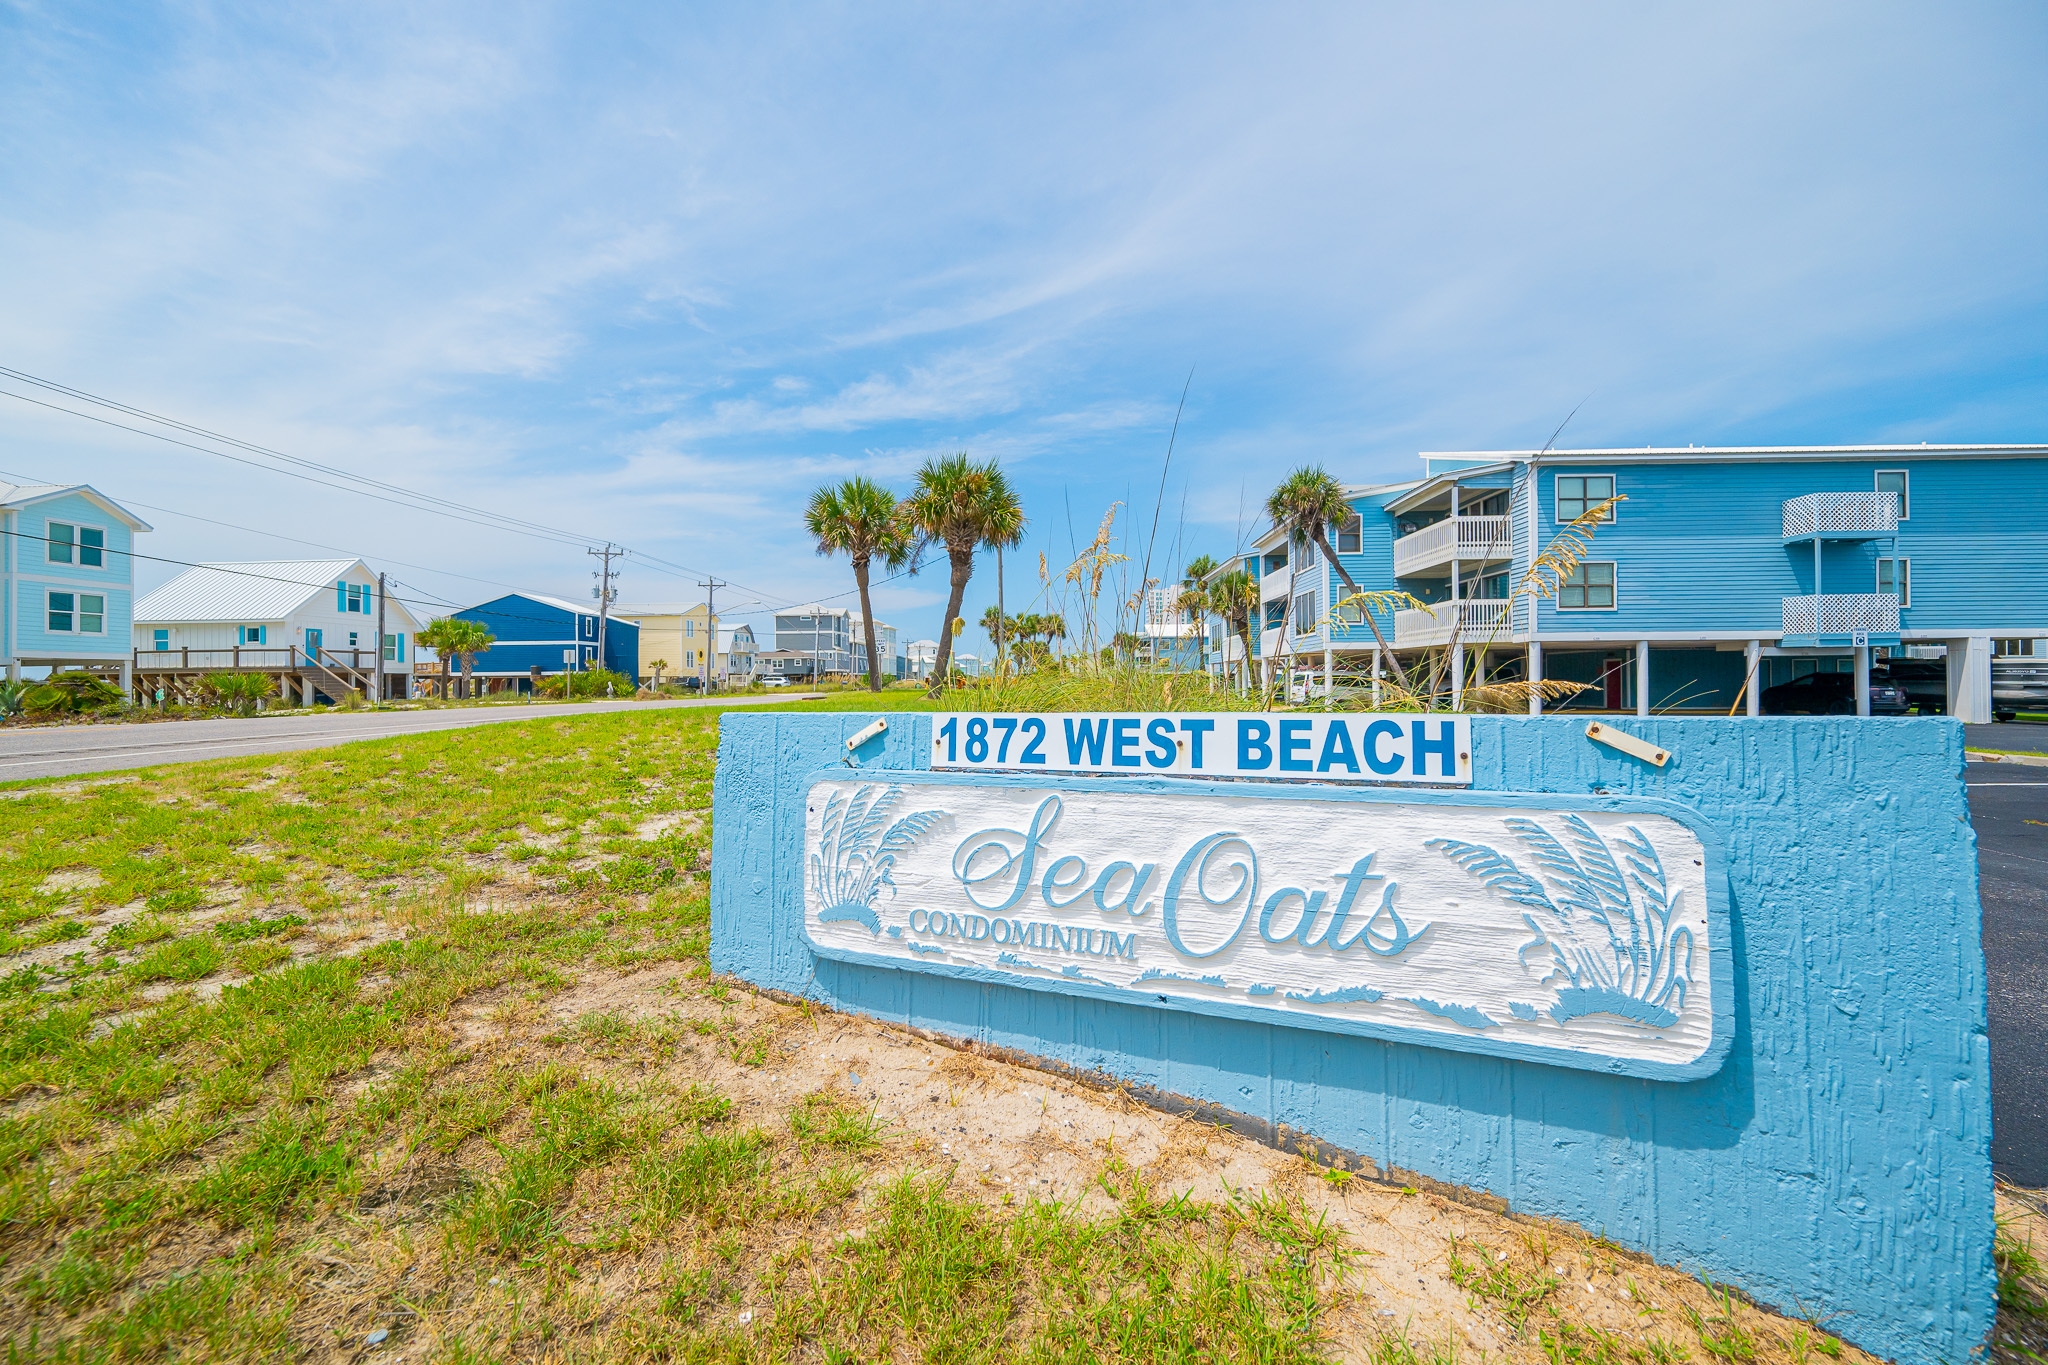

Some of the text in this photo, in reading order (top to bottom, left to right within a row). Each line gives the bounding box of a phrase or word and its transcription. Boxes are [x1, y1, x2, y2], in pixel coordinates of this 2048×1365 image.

[875, 645, 886, 653] 35
[1856, 636, 1864, 645] C
[940, 717, 1456, 776] 1872 WEST BEACH
[952, 794, 1432, 958] Sea Oats
[908, 908, 1137, 960] CONDOMINIUM
